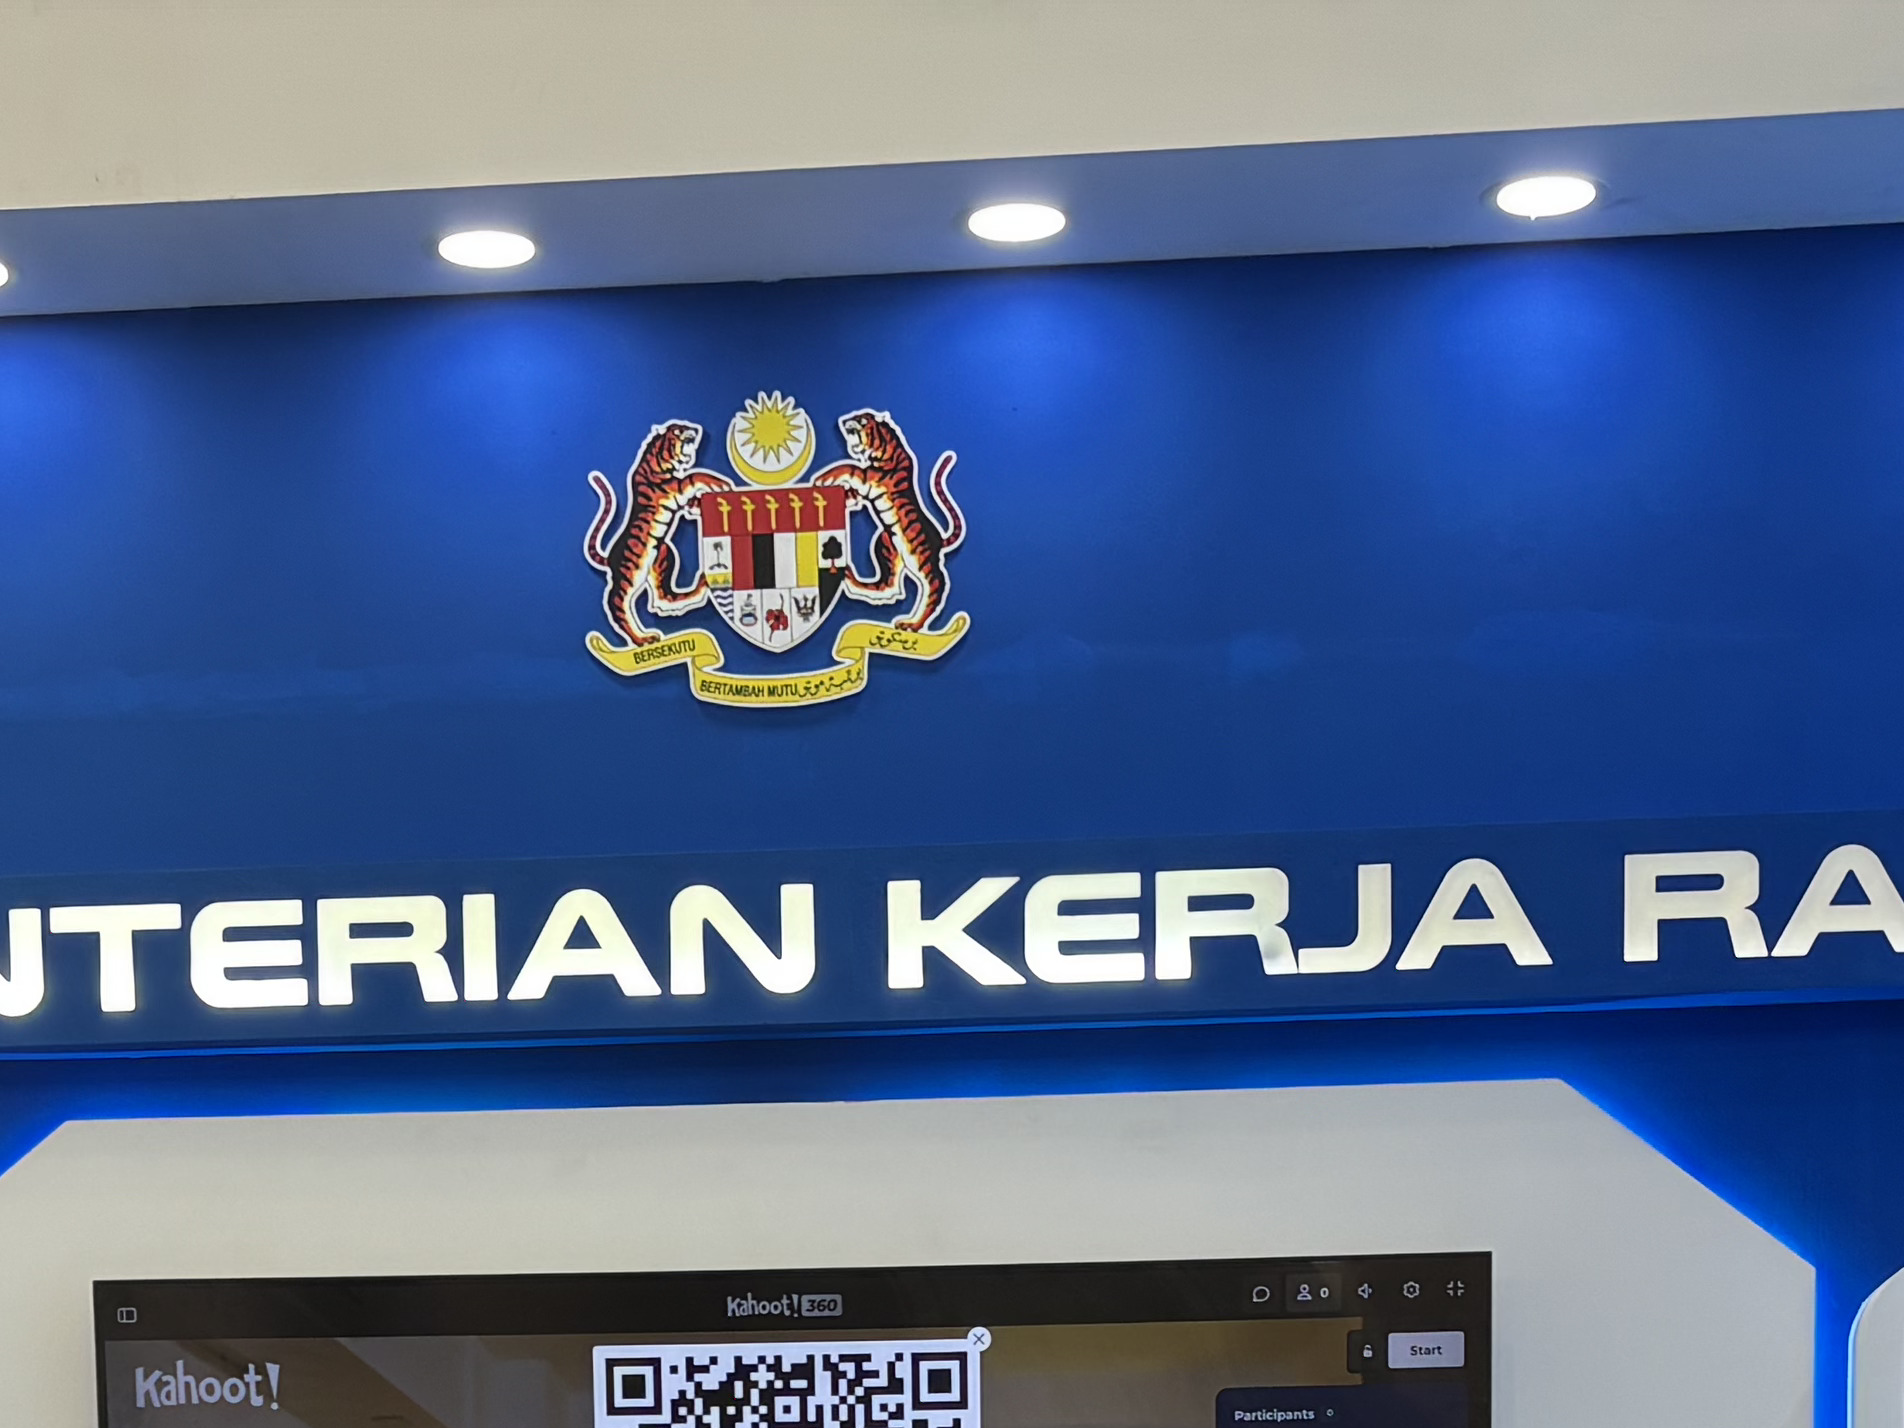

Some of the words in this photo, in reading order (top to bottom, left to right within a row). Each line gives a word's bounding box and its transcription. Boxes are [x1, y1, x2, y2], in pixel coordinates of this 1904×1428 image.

[633, 639, 696, 664] BERSEKUTU
[699, 680, 766, 698] BERTAMBAH
[767, 682, 797, 698] MUTU
[888, 851, 1552, 989] KERJA
[726, 1292, 800, 1318] Kahoot!
[805, 1297, 839, 1313] 360
[1410, 1345, 1442, 1356] Start
[135, 1360, 281, 1411] Kahoot!
[1234, 1409, 1315, 1422] Participants
